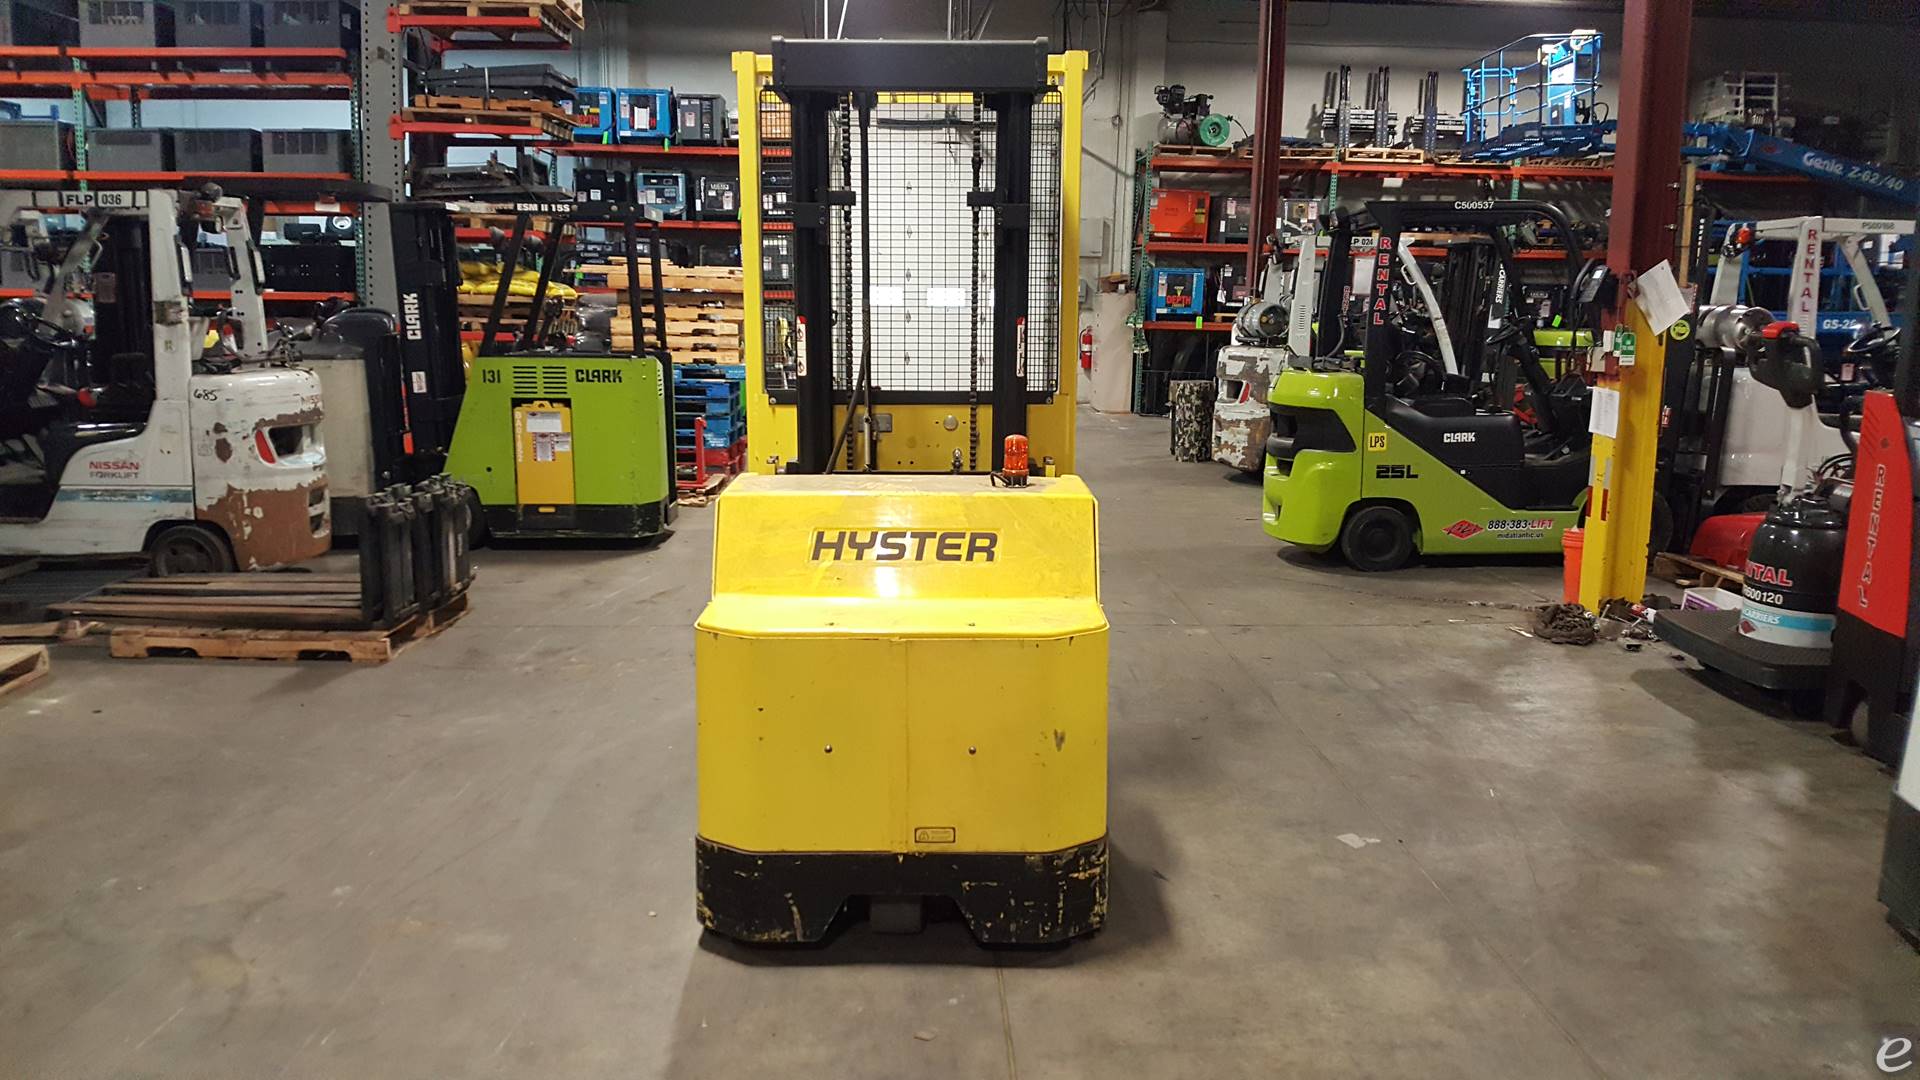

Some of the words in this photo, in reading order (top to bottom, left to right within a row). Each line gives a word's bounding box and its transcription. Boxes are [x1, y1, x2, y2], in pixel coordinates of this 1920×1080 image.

[1803, 151, 1845, 176] Genie
[66, 194, 93, 206] FLP
[101, 193, 122, 205] 036
[1454, 200, 1495, 210] C500537
[516, 202, 539, 212] ESM
[550, 203, 571, 213] 15S
[1801, 228, 1817, 312] RENTAL
[1373, 236, 1393, 325] RENTAL
[403, 292, 422, 340] CLARK
[482, 369, 501, 384] 131
[575, 369, 623, 383] CLARK
[193, 388, 218, 401] 685
[1369, 436, 1385, 448] LPS
[1443, 431, 1476, 443] CLARK
[89, 460, 140, 470] NISSAN
[1376, 464, 1419, 479] 25L
[89, 471, 139, 479] FORKLIFT
[1857, 464, 1886, 608] RENTAL
[811, 531, 998, 562] HYSTER
